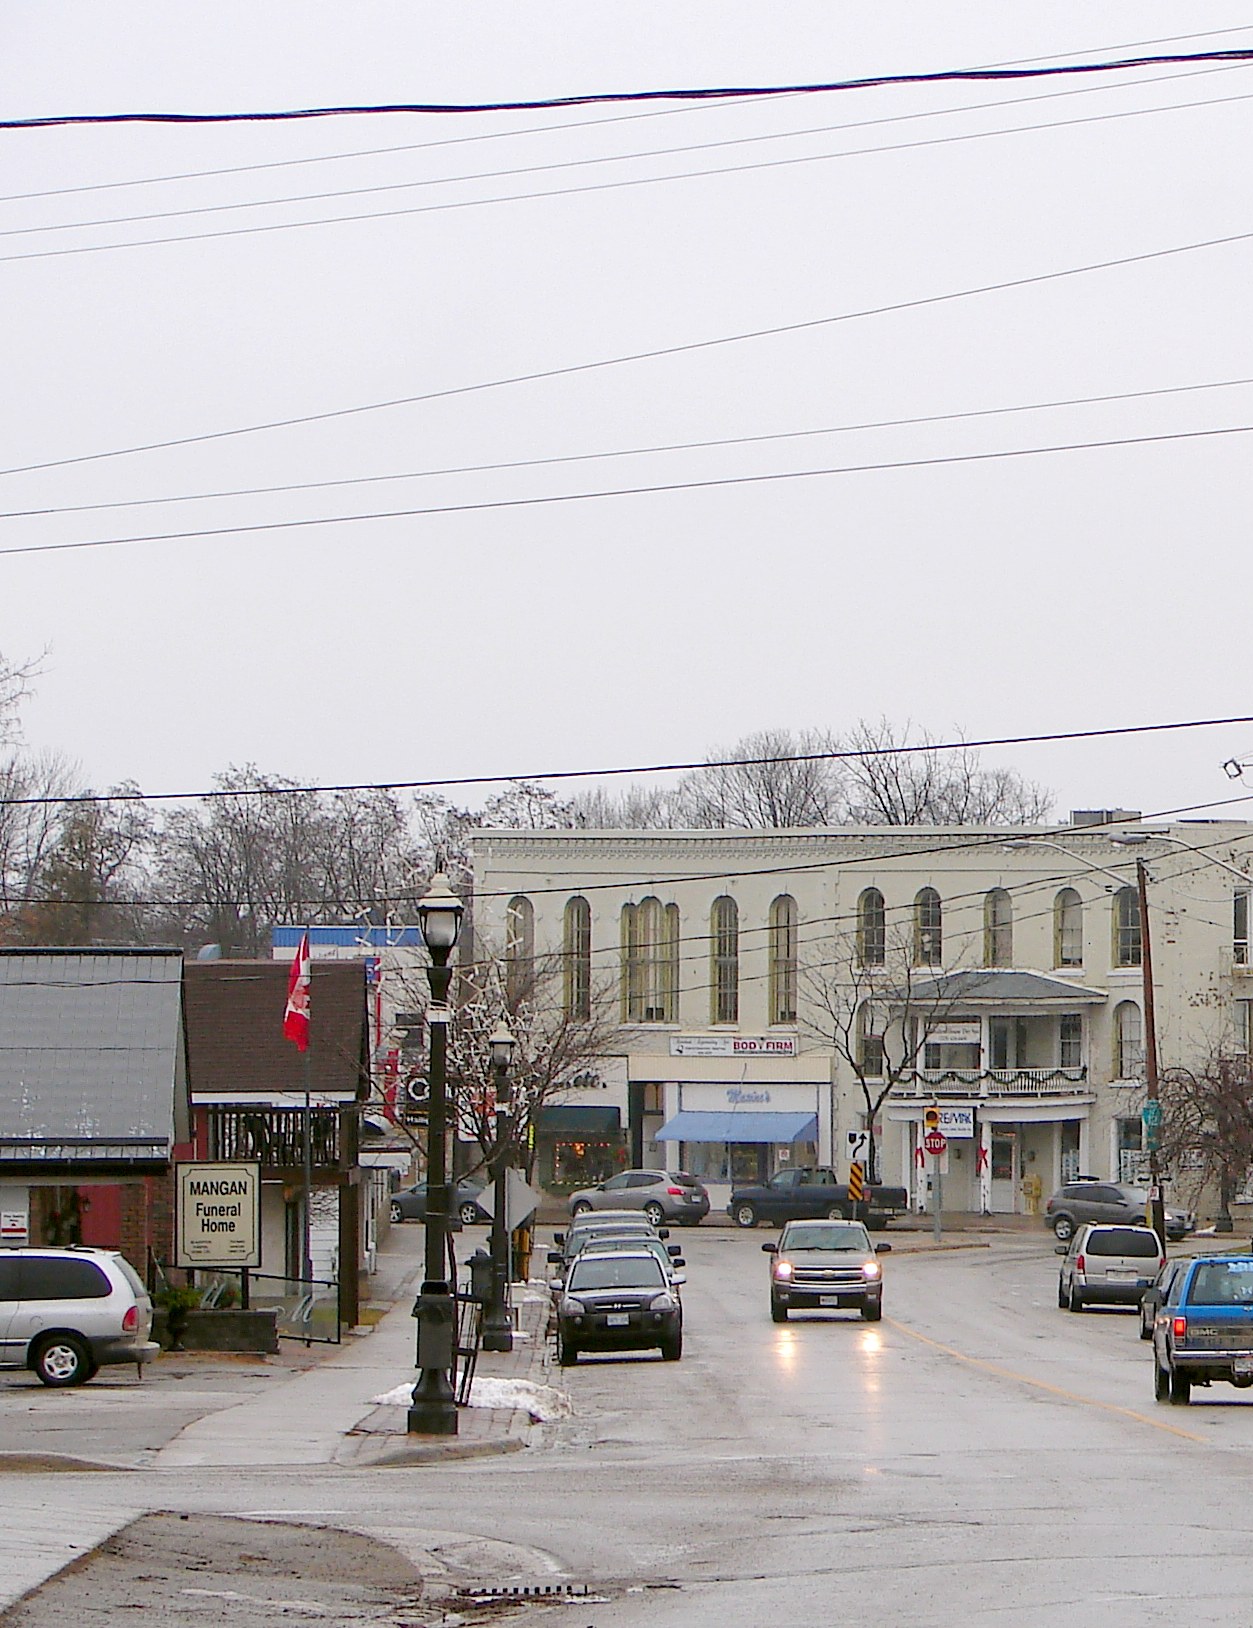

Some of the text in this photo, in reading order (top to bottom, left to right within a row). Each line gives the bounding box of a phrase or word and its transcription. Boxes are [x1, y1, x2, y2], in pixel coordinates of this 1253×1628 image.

[766, 1041, 793, 1050] FIRM
[925, 1139, 947, 1149] STOP
[190, 1181, 247, 1195] MANGAN
[196, 1202, 241, 1216] Funeral
[201, 1218, 235, 1232] Home
[1190, 1328, 1218, 1336] GMC
